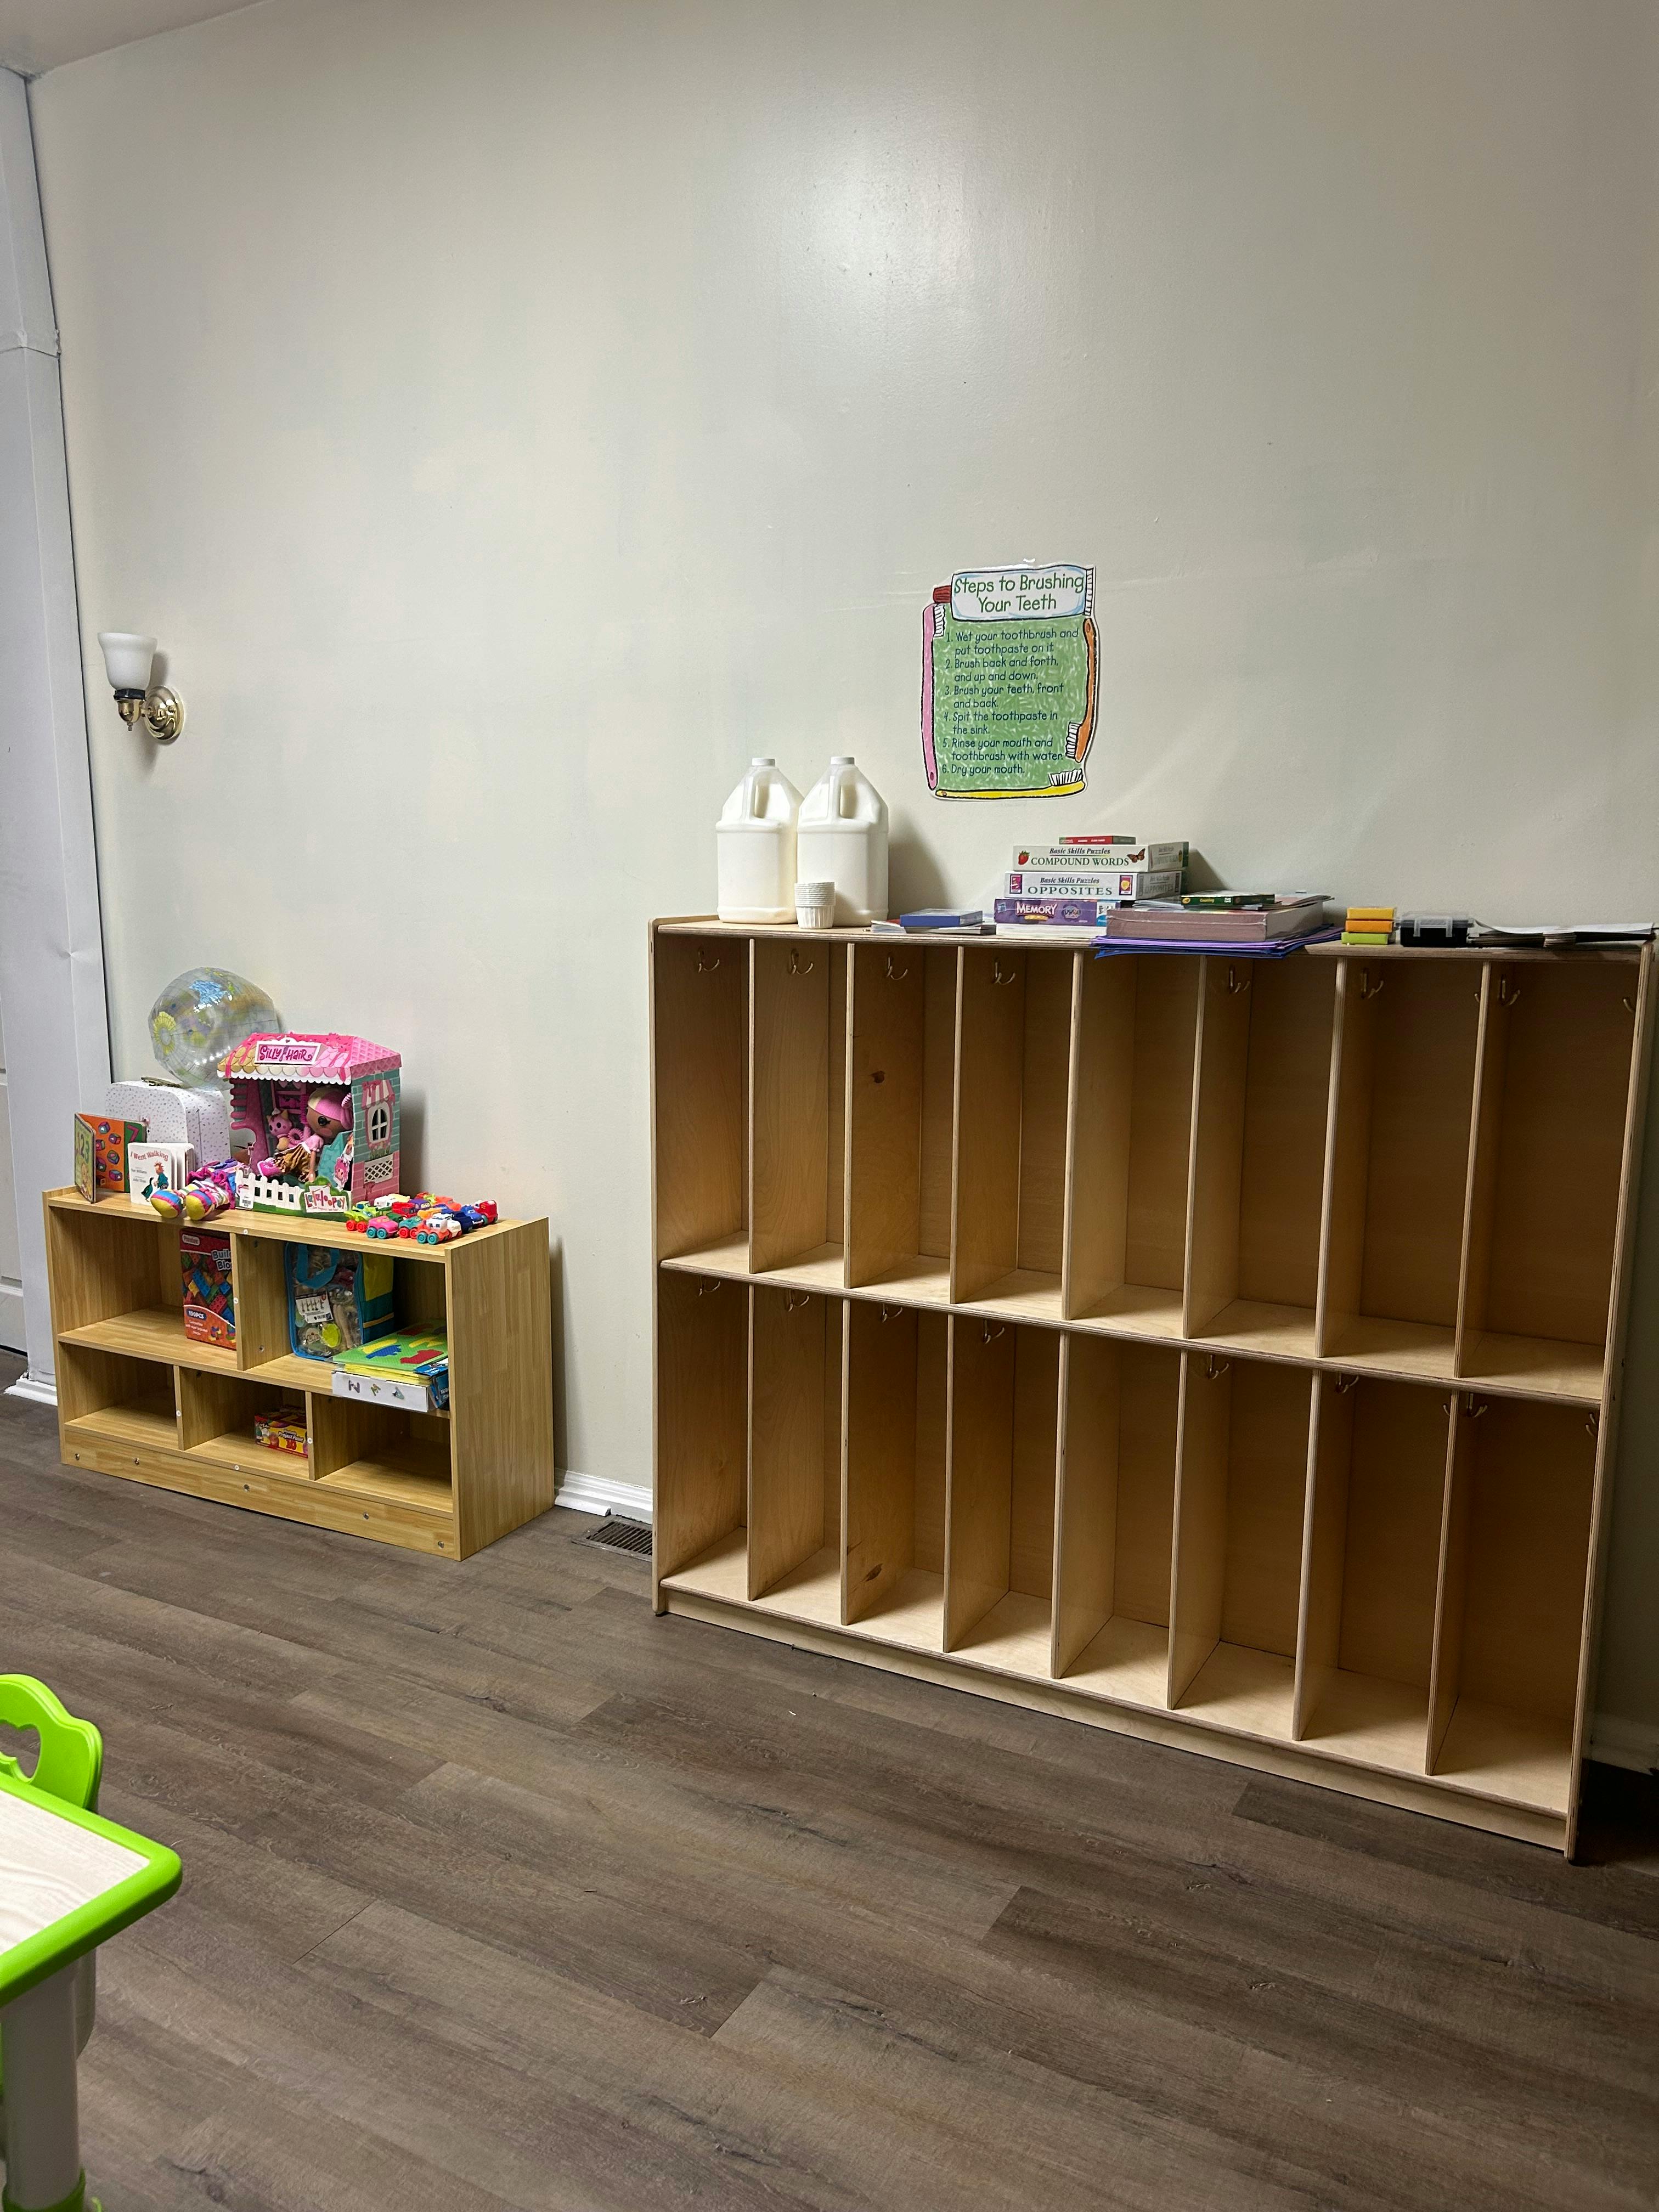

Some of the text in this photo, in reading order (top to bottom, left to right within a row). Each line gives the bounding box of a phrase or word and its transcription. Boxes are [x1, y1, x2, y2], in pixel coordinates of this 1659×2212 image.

[954, 572, 1084, 597] Steps to Brushing
[978, 594, 1057, 613] Your Teeth
[947, 628, 1079, 644] 1. Wet your toothbrush and
[955, 646, 970, 658] put
[974, 644, 1028, 656] toothpaste
[945, 655, 1059, 669] 2. Brush back and forth,
[954, 670, 1038, 684] and up and down.
[945, 682, 1064, 697] 3. Brush your teeth, front
[953, 697, 998, 708] and back.
[944, 710, 1058, 725] 4. Spit the toothpaste in
[952, 724, 990, 735] the sink.
[943, 737, 1053, 750] 5. Rinse your mouth and
[951, 751, 1063, 761] toothbrush with water.
[942, 764, 1025, 776] 6. Dry your mouth.
[1031, 857, 1129, 866] COMPOUND WORDS
[1028, 886, 1113, 896] OPPOSITES
[1015, 901, 1058, 916] MEMORY
[134, 1152, 146, 1160] Went
[146, 1150, 168, 1162] Walking
